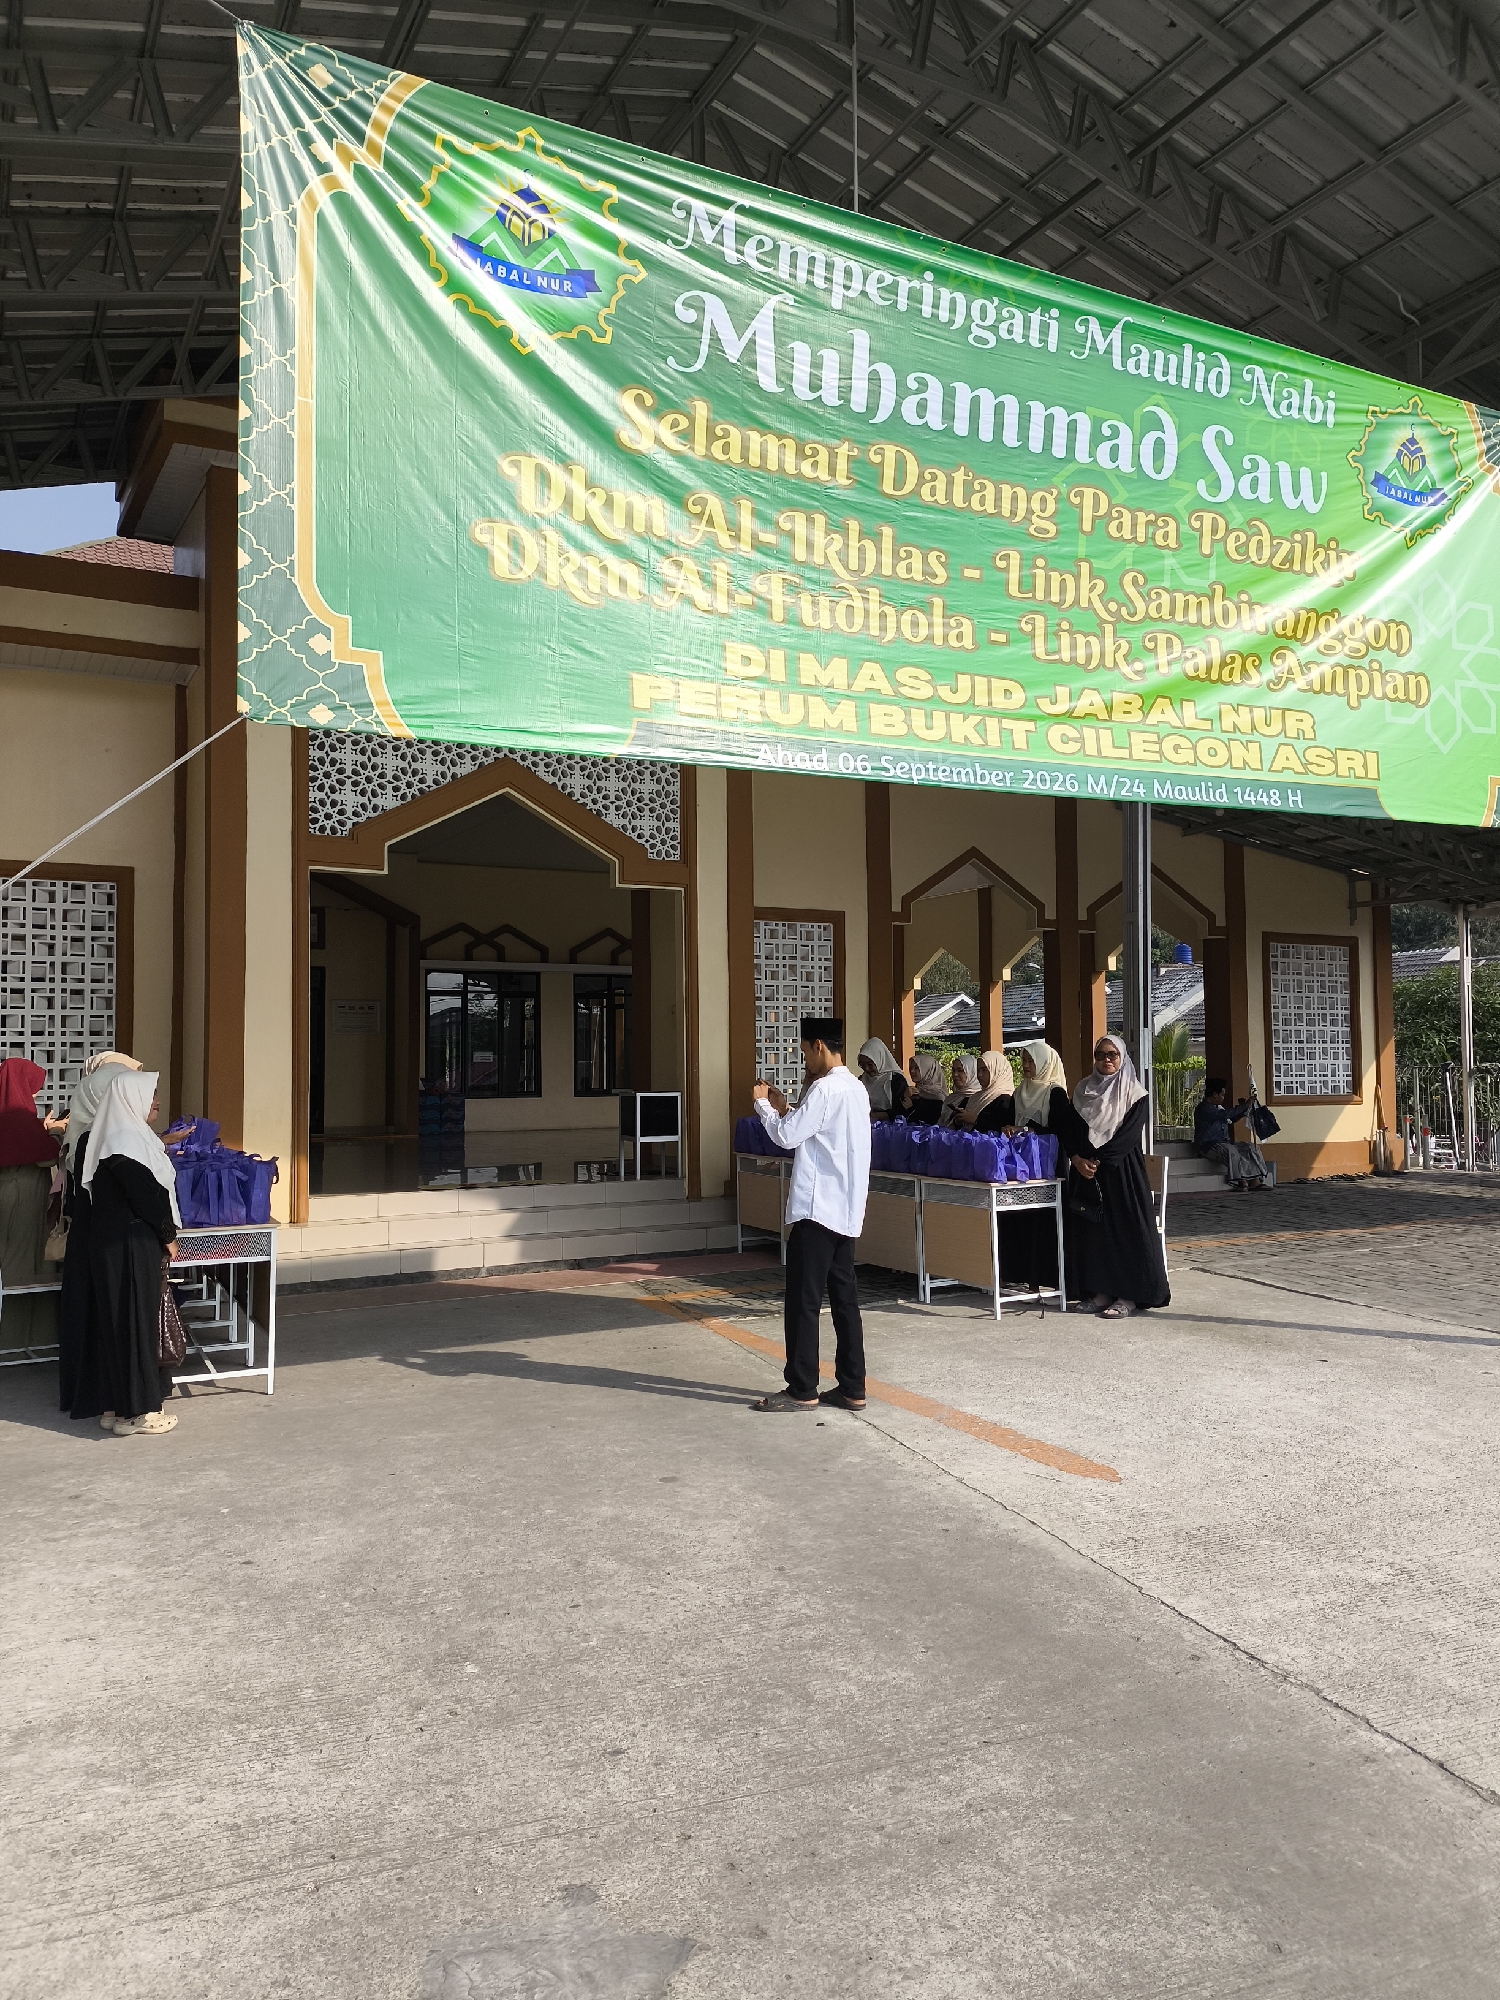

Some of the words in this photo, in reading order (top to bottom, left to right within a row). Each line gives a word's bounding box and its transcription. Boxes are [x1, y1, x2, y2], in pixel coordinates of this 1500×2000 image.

[536, 275, 573, 293] NUR
[666, 198, 1060, 353] Memperingati
[1070, 316, 1231, 398] Maulid
[1240, 364, 1337, 428] Nabi
[666, 290, 1179, 480] Muhammad
[1197, 424, 1329, 514] Saw
[500, 455, 667, 541] Dkm
[679, 493, 948, 585] Al-Ikhlas
[619, 388, 859, 487] Selamat
[868, 444, 1058, 539] Datang
[1069, 487, 1181, 550] Para
[1189, 512, 1361, 586] Pedzikir
[1385, 486, 1413, 502] JABAL
[1414, 494, 1435, 504] NUR
[474, 522, 643, 605] Dkm
[653, 556, 977, 650] Al-Fudhola
[1269, 649, 1429, 707] Ampian
[631, 672, 858, 732] PERUM
[869, 703, 1037, 750] BUKIT
[1047, 723, 1263, 771] CILEGON
[1269, 743, 1380, 780] ASRI
[725, 642, 786, 683] DI
[799, 651, 1026, 710] MASJID
[1036, 685, 1213, 731] JABAL
[1219, 702, 1316, 740] NUR
[757, 744, 829, 771] Ahad
[838, 751, 872, 776] 06
[880, 755, 1015, 787] September
[1021, 769, 1079, 793] 2026
[1086, 773, 1147, 798] M/24
[1152, 778, 1230, 803] Maulid
[1233, 786, 1282, 807] 1448
[1288, 789, 1304, 809] H
